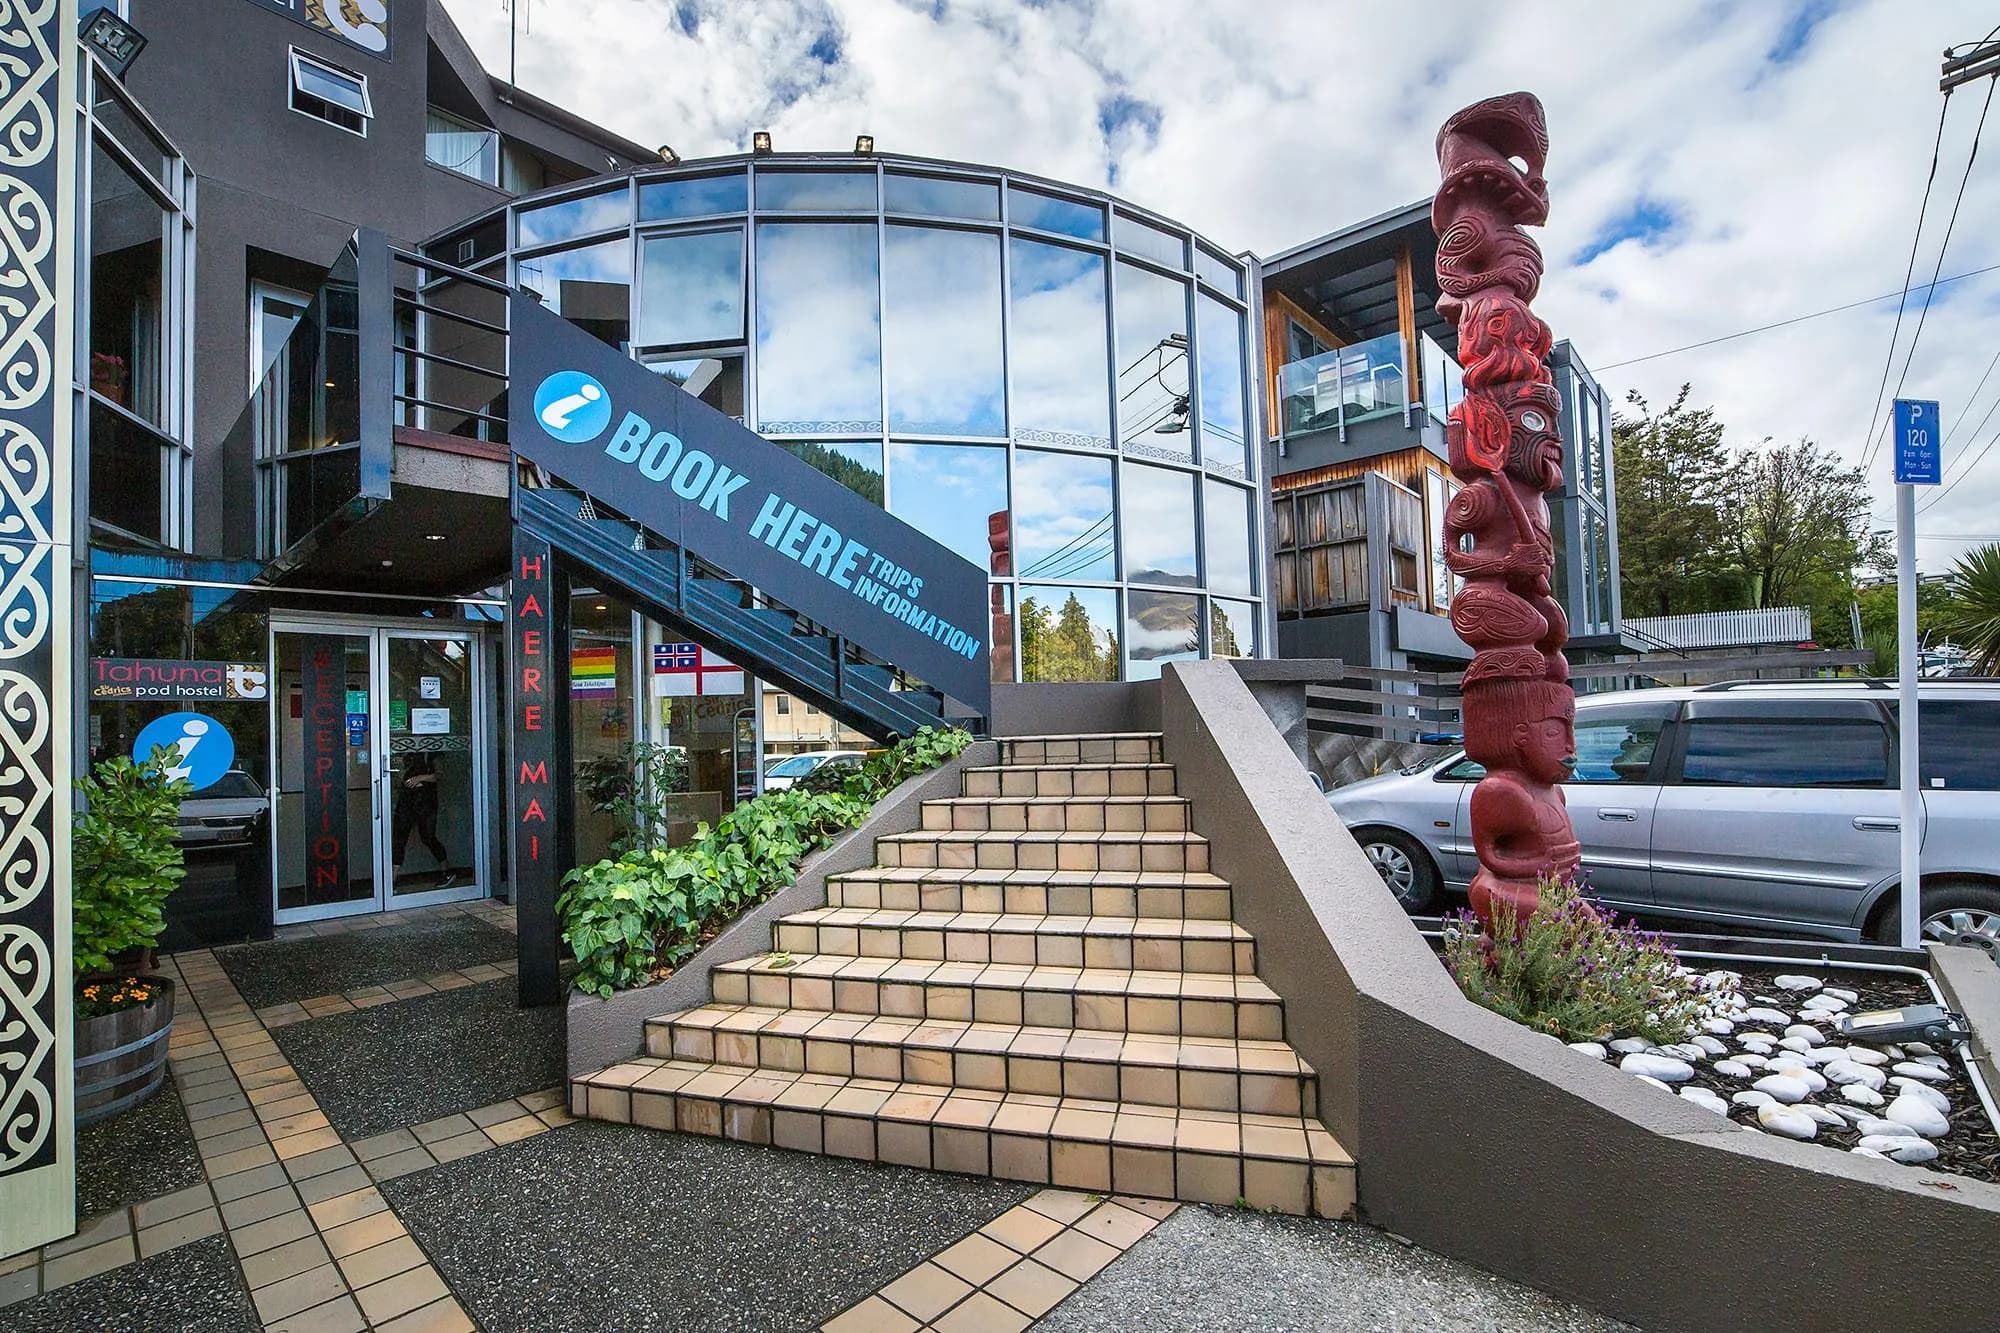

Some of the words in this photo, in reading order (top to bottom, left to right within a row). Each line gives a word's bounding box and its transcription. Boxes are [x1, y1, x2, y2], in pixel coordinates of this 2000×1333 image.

[1911, 404, 1923, 425] P
[1907, 429, 1928, 447] 120
[605, 410, 750, 522] BOOK
[748, 492, 870, 590] HERE
[867, 551, 924, 599] TRIPS
[852, 574, 981, 661] INFORMATION
[519, 555, 545, 731] HAERE
[94, 658, 223, 684] Tahuna
[135, 684, 170, 698] pod
[176, 684, 222, 697] hostel
[351, 719, 364, 728] 9.1
[519, 759, 548, 862] MAI
